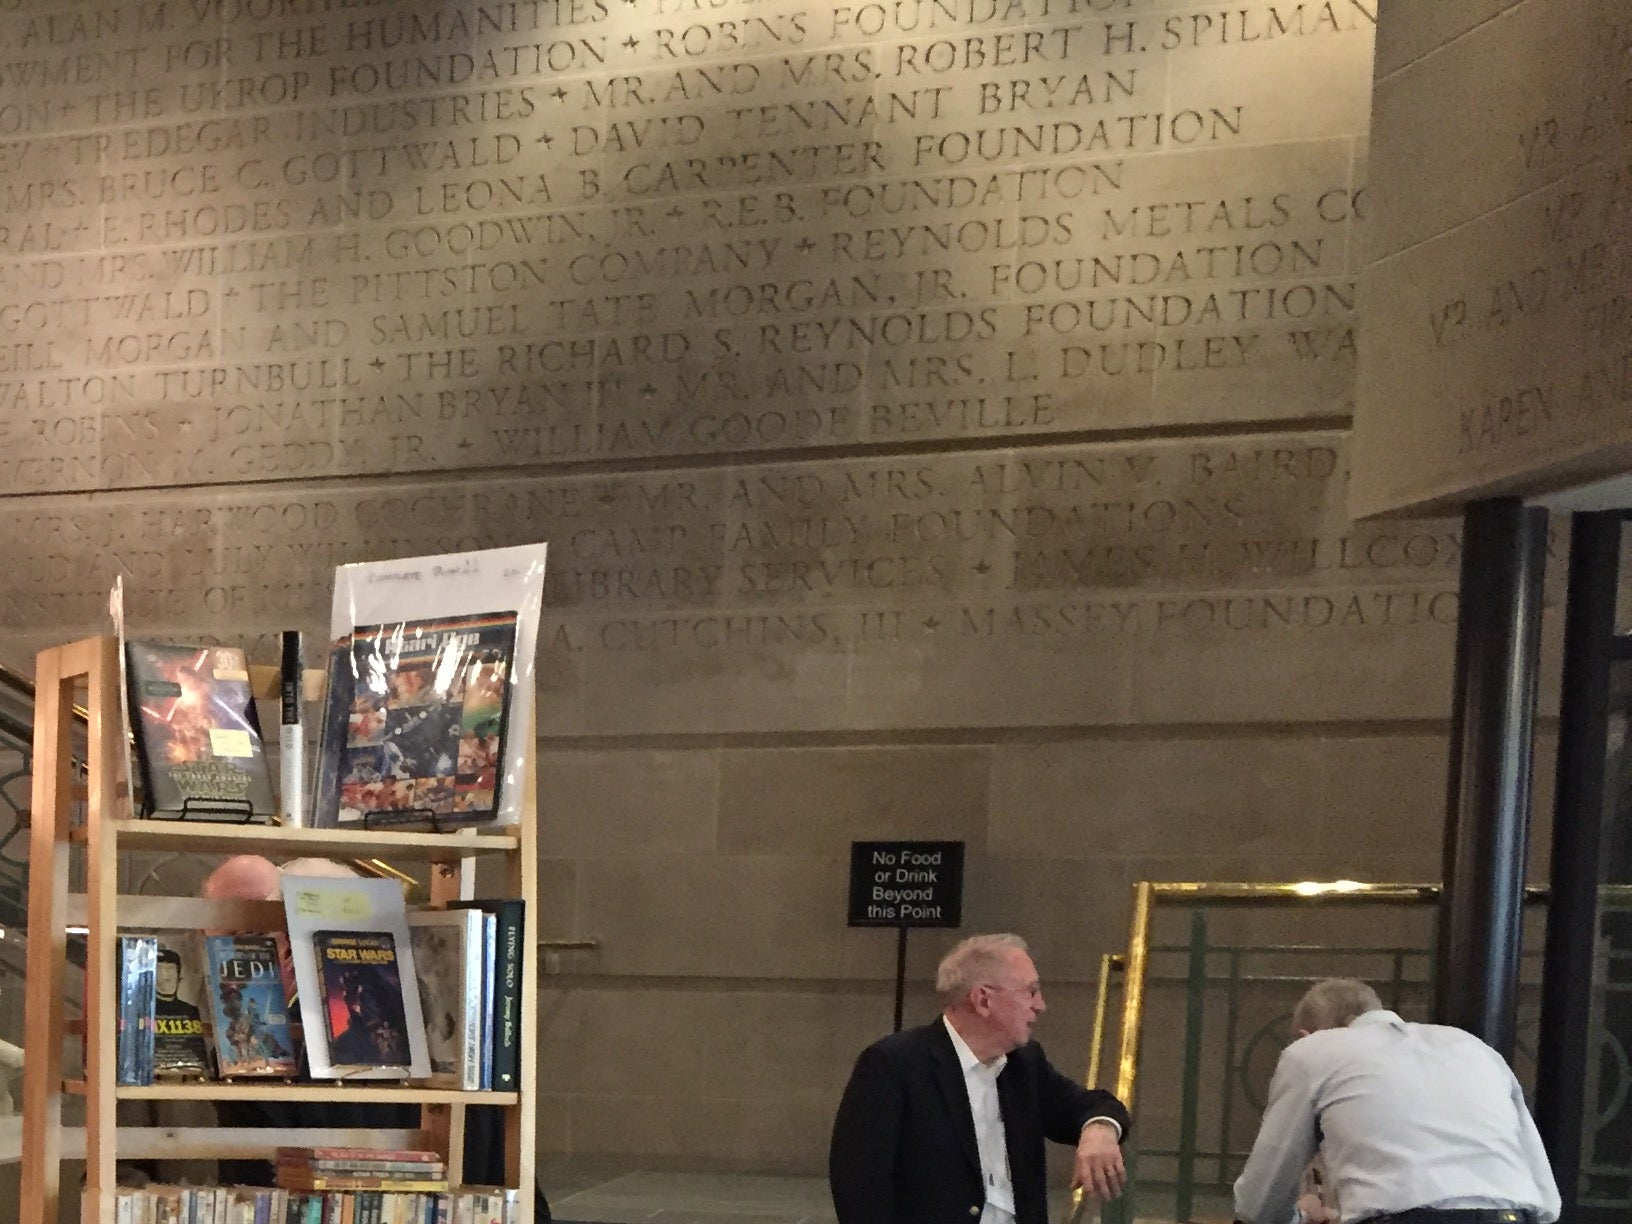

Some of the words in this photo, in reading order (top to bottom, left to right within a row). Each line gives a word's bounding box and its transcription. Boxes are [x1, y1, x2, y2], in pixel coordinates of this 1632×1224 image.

[22, 8, 120, 49] ALAN
[165, 36, 234, 74] FOR
[252, 25, 329, 64] THE
[347, 0, 609, 52] HUMANITIES
[89, 88, 163, 123] THE
[329, 36, 607, 97] FOUNDATION
[654, 12, 808, 59] ROBINS
[69, 117, 269, 165] TREDEGAR
[296, 87, 535, 141] INDUSTRIES
[584, 75, 654, 110] MR.
[665, 62, 760, 101] AND
[778, 47, 880, 90] MRS.
[897, 26, 1085, 77] ROBERT
[1104, 23, 1147, 56] H.
[98, 164, 220, 205] BRUCE
[283, 133, 521, 187] GOTTWALD
[570, 113, 705, 157] DAVID
[726, 86, 953, 141] TENNANT
[978, 69, 1138, 116] BRYAN
[138, 200, 290, 241] RHODES
[309, 190, 393, 225] AND
[415, 174, 552, 216] LEONA
[623, 141, 886, 195] CARPENTER
[913, 106, 1244, 167] FOUNDATION
[169, 239, 314, 279] WILLIAM
[823, 161, 1124, 217] FOUNDATION
[251, 278, 329, 313] THE
[352, 257, 549, 304] PITTSTON
[569, 237, 783, 286] COMPANY
[831, 211, 1074, 263] REYNOLDS
[1102, 193, 1290, 241] METALS
[84, 326, 245, 366] MORGAN
[267, 318, 349, 352] AND
[371, 303, 529, 346] SAMUEL
[548, 293, 658, 331] TATE
[991, 238, 1325, 296] FOUNDATION
[155, 357, 361, 401] TURNBULL
[396, 348, 479, 382] THE
[498, 331, 689, 376] RICHARD
[759, 306, 997, 356] REYNOLDS
[1023, 281, 1358, 339] FOUNDATION
[210, 393, 423, 443] JONATHAN
[438, 382, 568, 421] BRYAN
[766, 361, 863, 397] AND
[1061, 334, 1259, 380] DUDLEY
[870, 394, 1054, 435] BEVILLE
[727, 475, 823, 509] AND
[575, 563, 724, 601] IBRARY
[739, 554, 946, 594] SERVICES
[961, 601, 1144, 637] MASSEY
[1154, 591, 1461, 630] FOUNDATIO
[872, 851, 896, 865] No
[900, 851, 942, 865] Food
[874, 871, 891, 883] or
[896, 868, 938, 883] Drink
[867, 904, 896, 919] this
[900, 904, 942, 919] Point
[872, 886, 933, 904] Beyond
[222, 960, 275, 978] JEDI
[326, 948, 358, 960] STAR
[359, 949, 395, 961] WARS
[155, 1019, 202, 1034] X1138
